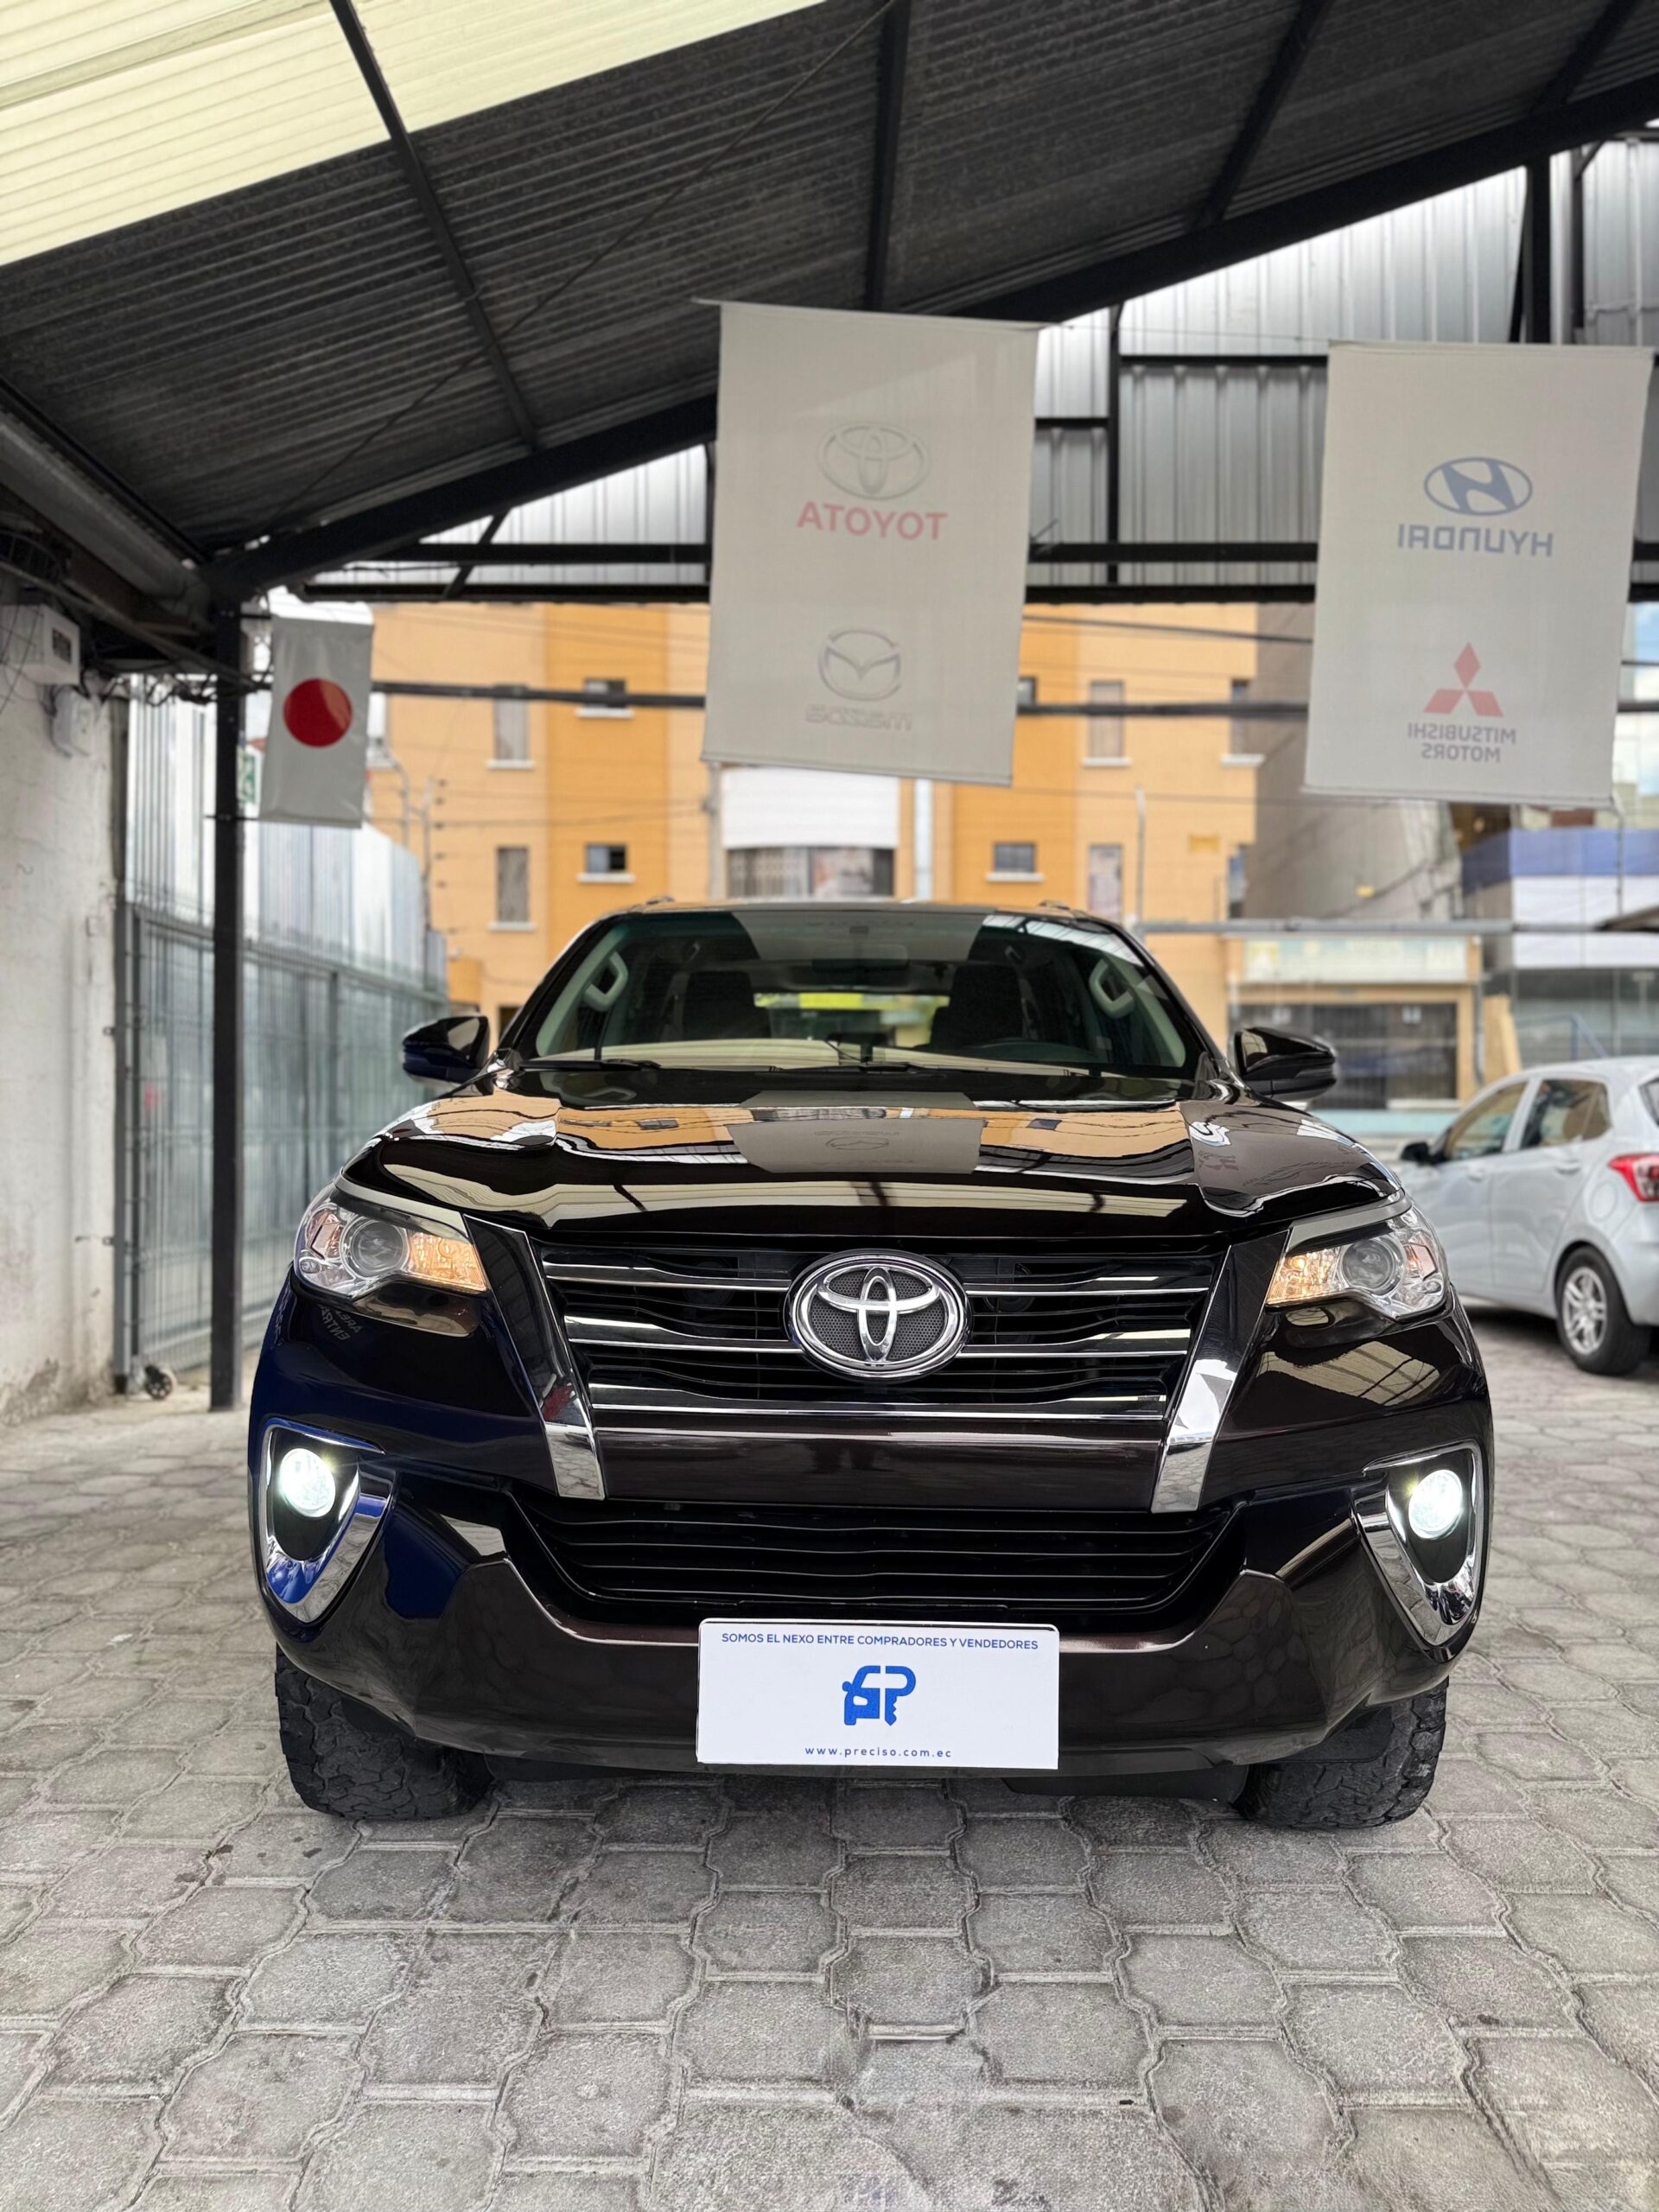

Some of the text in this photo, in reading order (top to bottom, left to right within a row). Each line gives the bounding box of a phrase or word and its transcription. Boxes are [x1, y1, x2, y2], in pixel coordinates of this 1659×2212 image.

[721, 1633, 1039, 1649] SOMOS EL NEXO ENTRE COMPRADORES Y VENDEDORES
[804, 1746, 952, 1758] www.preciso.com.ec
